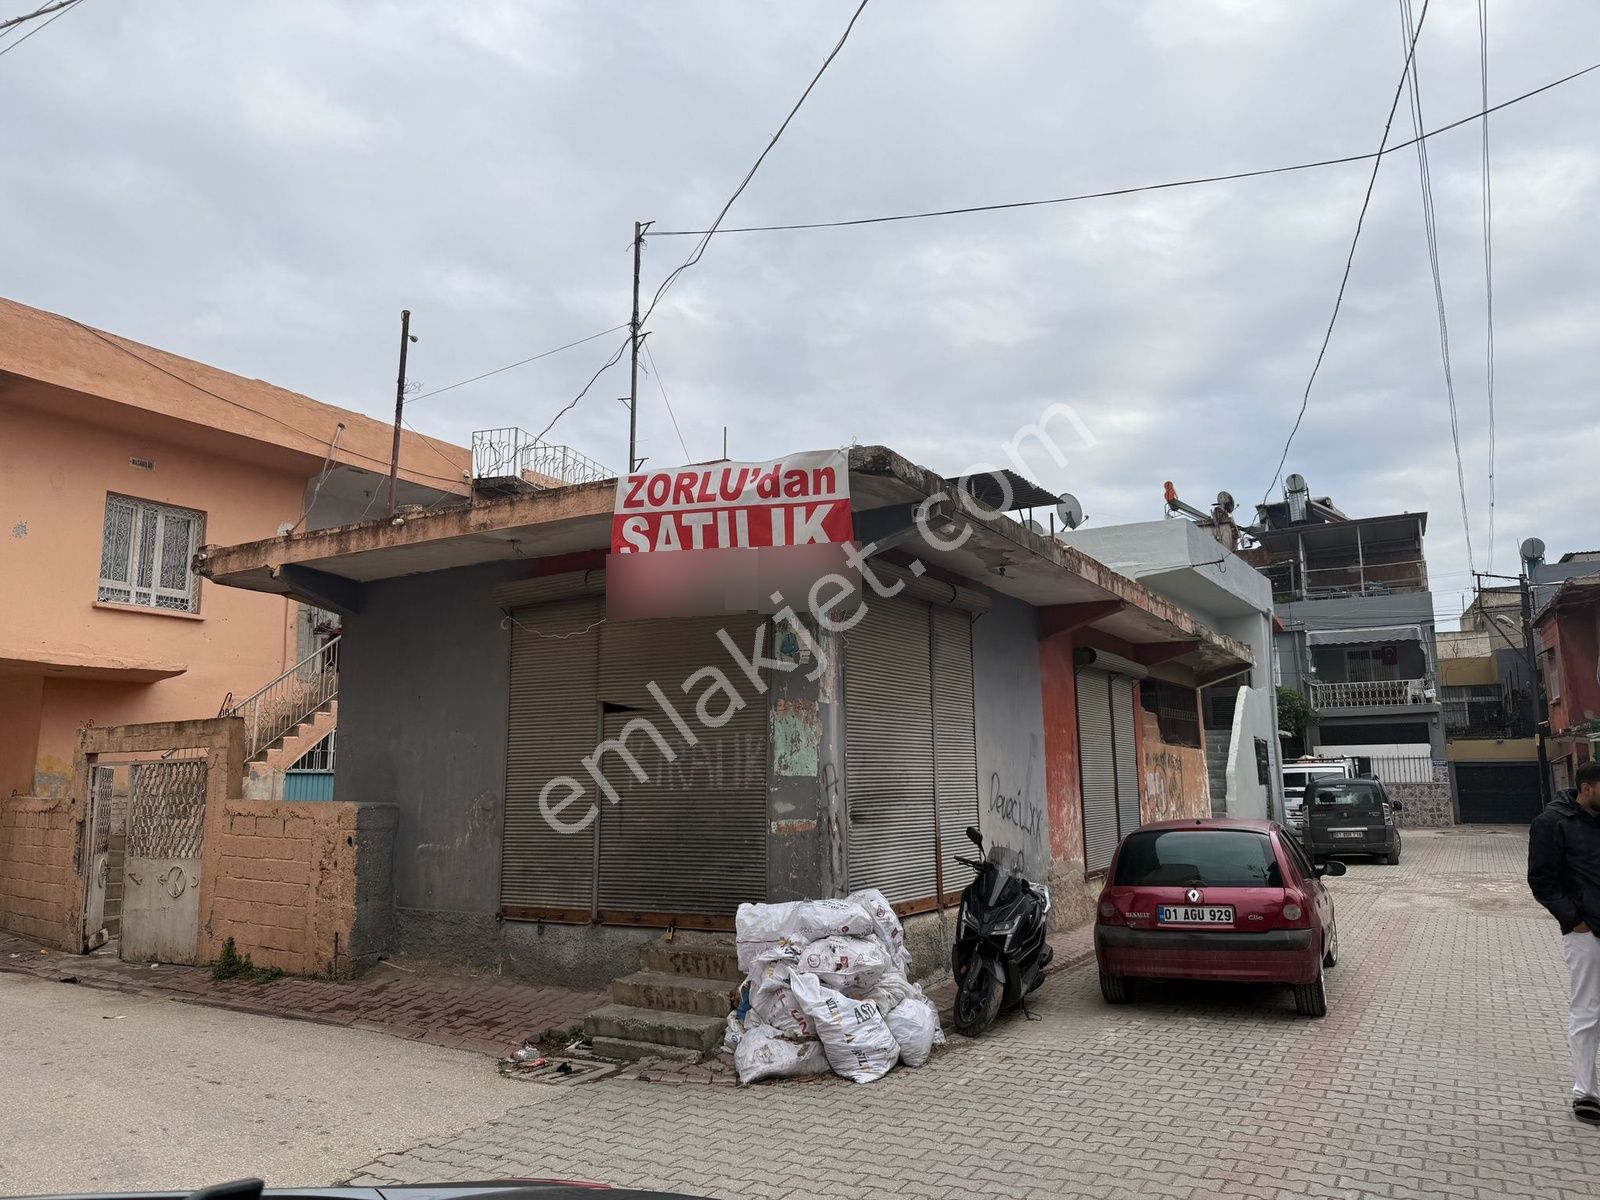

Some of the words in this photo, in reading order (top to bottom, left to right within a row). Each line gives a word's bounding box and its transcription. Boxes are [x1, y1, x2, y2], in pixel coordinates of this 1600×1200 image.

[620, 503, 835, 554] SATILIK
[1165, 908, 1177, 920] 01
[1183, 909, 1204, 920] AGU
[1209, 909, 1231, 921] 929
